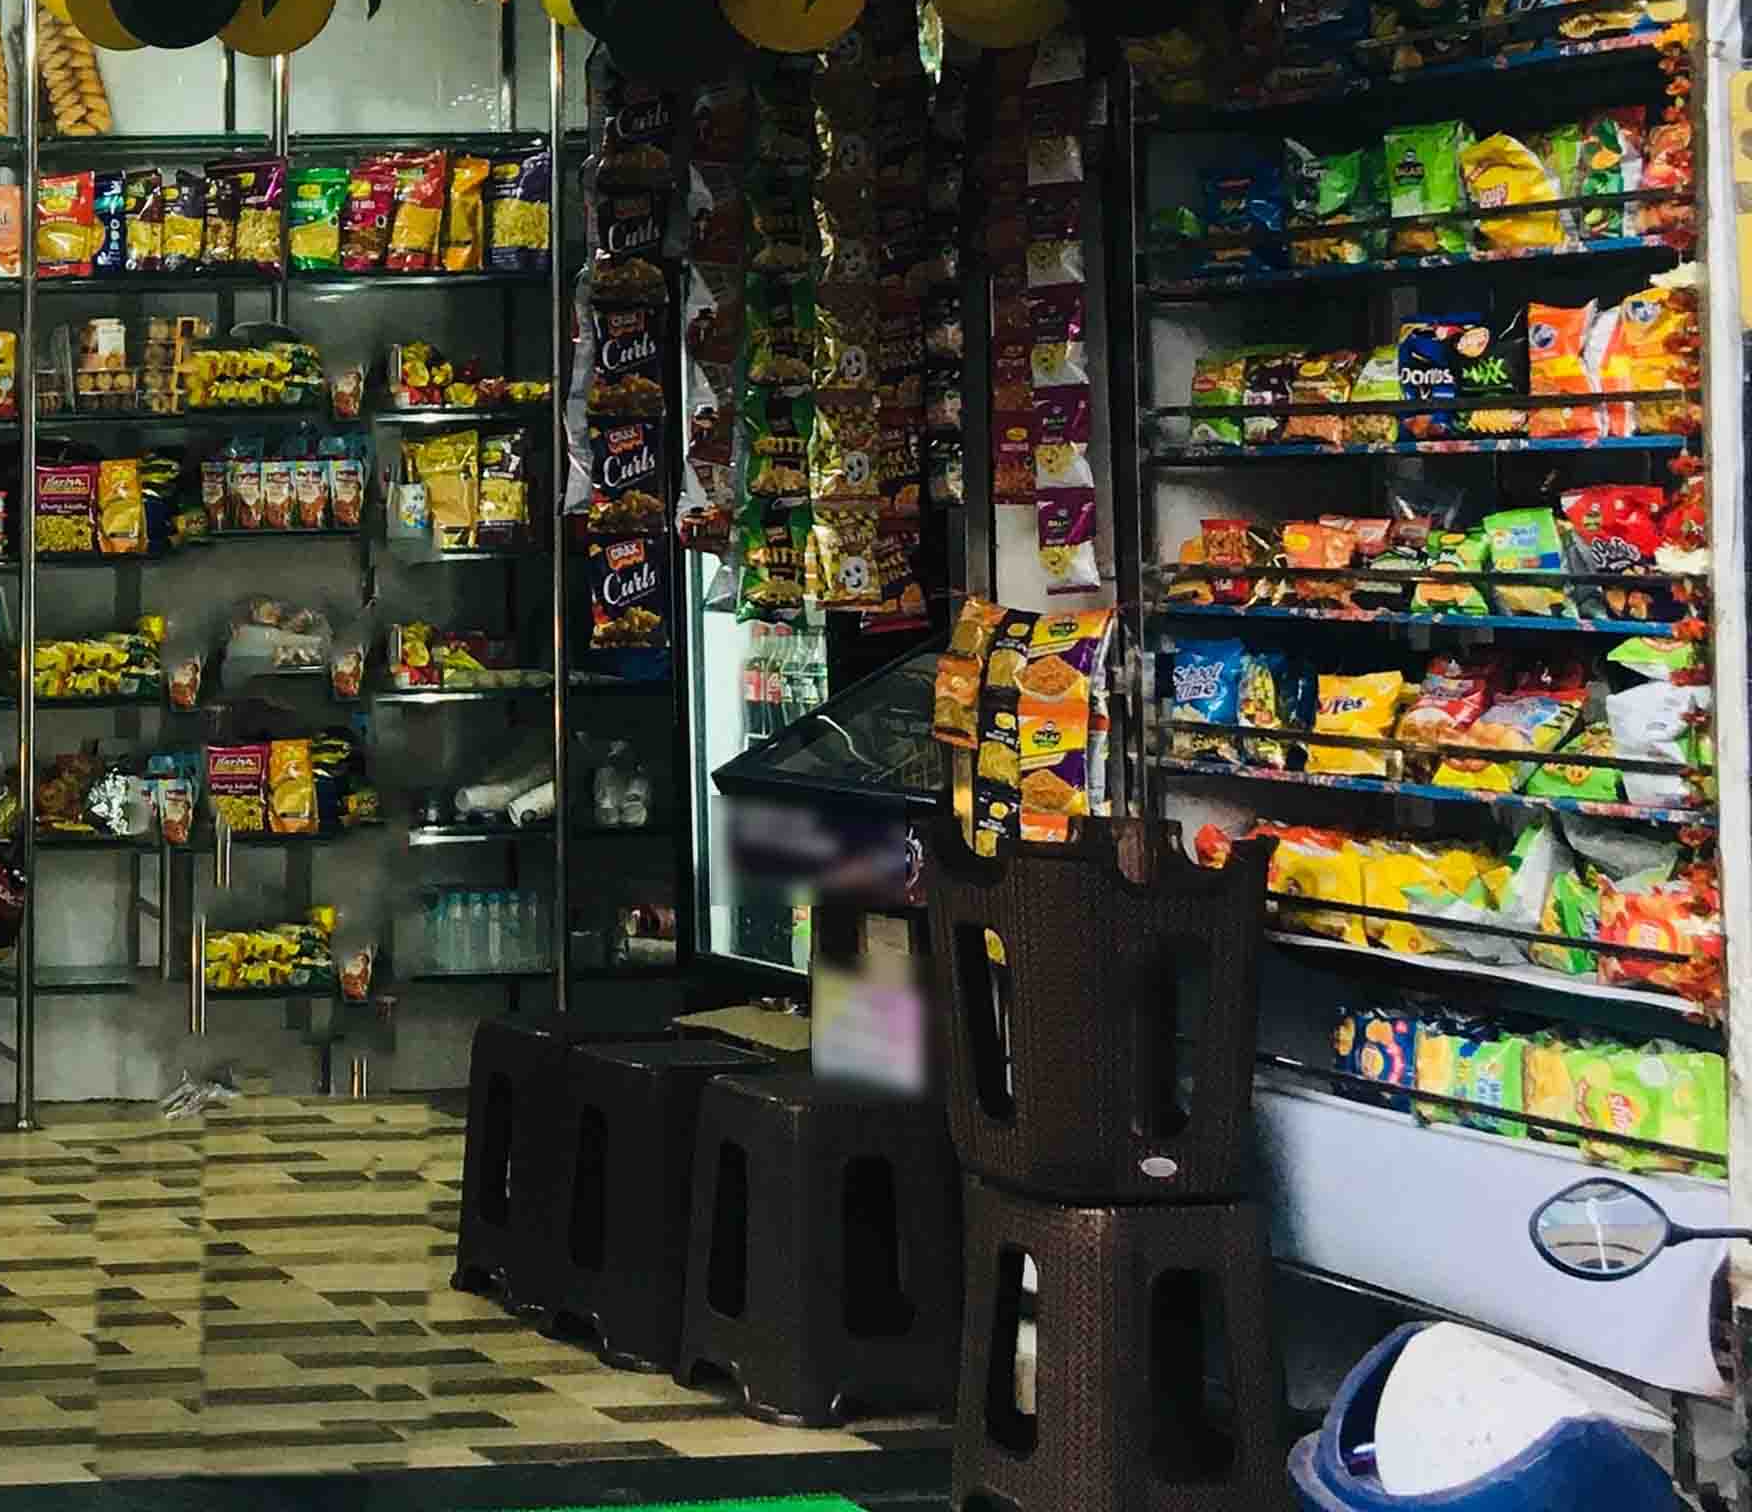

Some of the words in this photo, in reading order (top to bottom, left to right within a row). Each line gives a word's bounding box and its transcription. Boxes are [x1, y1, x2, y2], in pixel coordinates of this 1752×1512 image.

[607, 217, 662, 254] Curls
[601, 333, 657, 371] Curls
[602, 445, 656, 488] Curls
[602, 562, 657, 607] Curls
